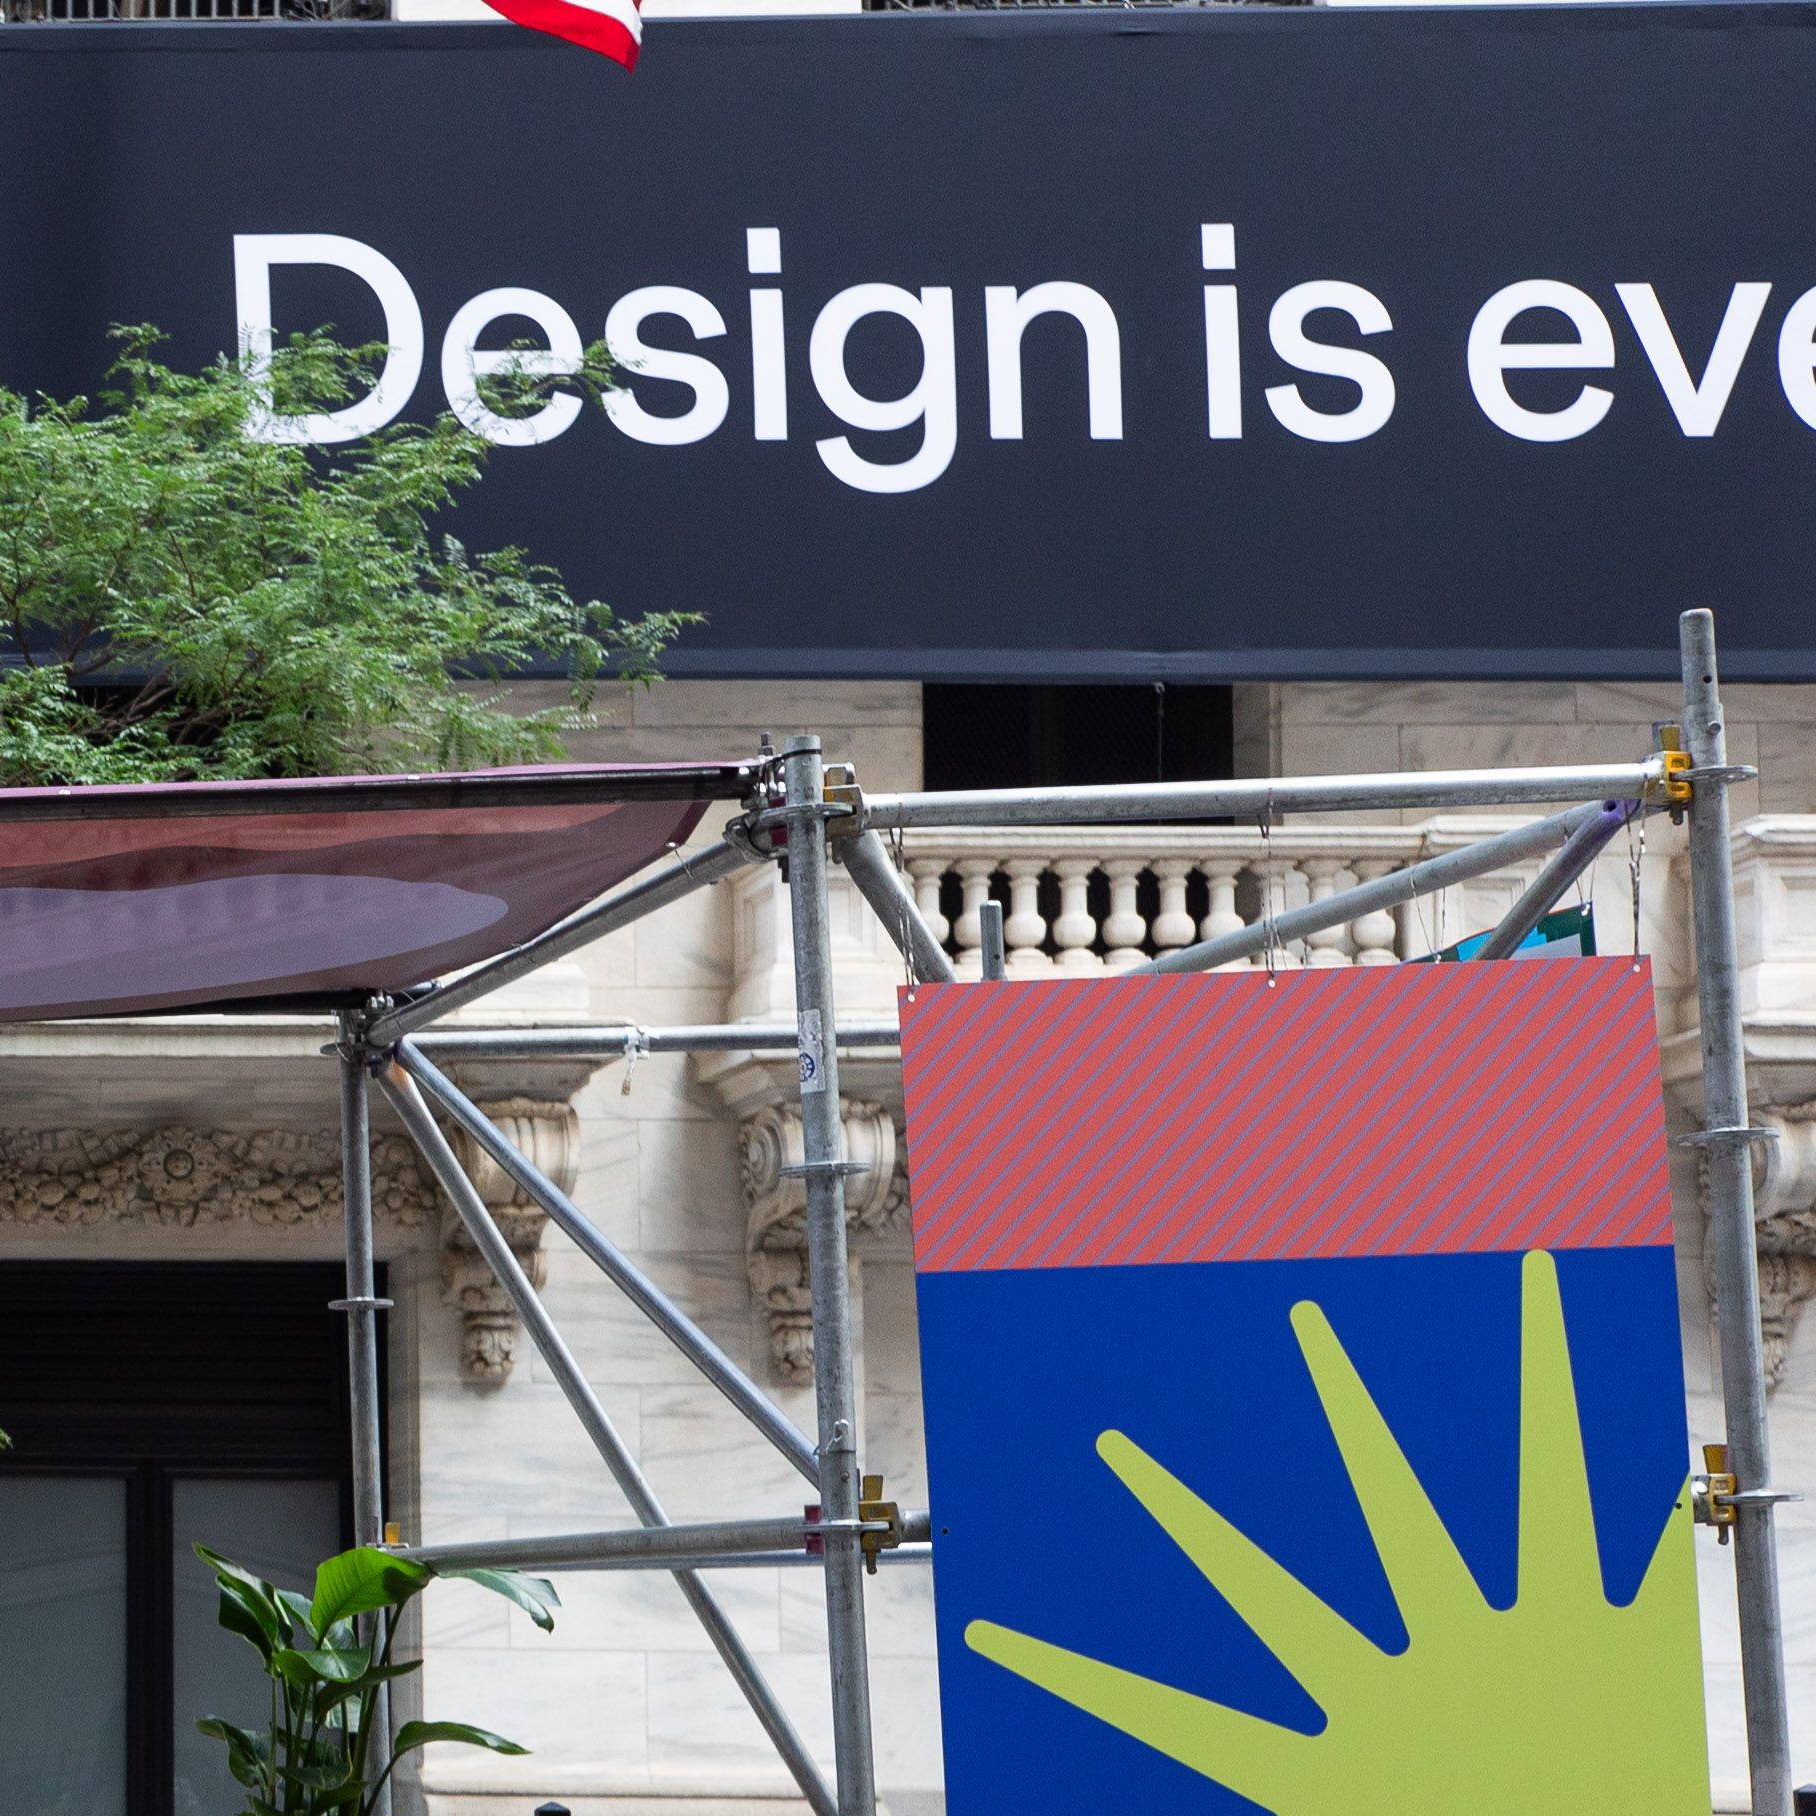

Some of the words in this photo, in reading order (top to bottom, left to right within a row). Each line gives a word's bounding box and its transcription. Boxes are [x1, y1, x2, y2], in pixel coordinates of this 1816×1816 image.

[232, 227, 1123, 493] Design
[1200, 222, 1394, 445] is
[1467, 279, 1816, 441] ev
